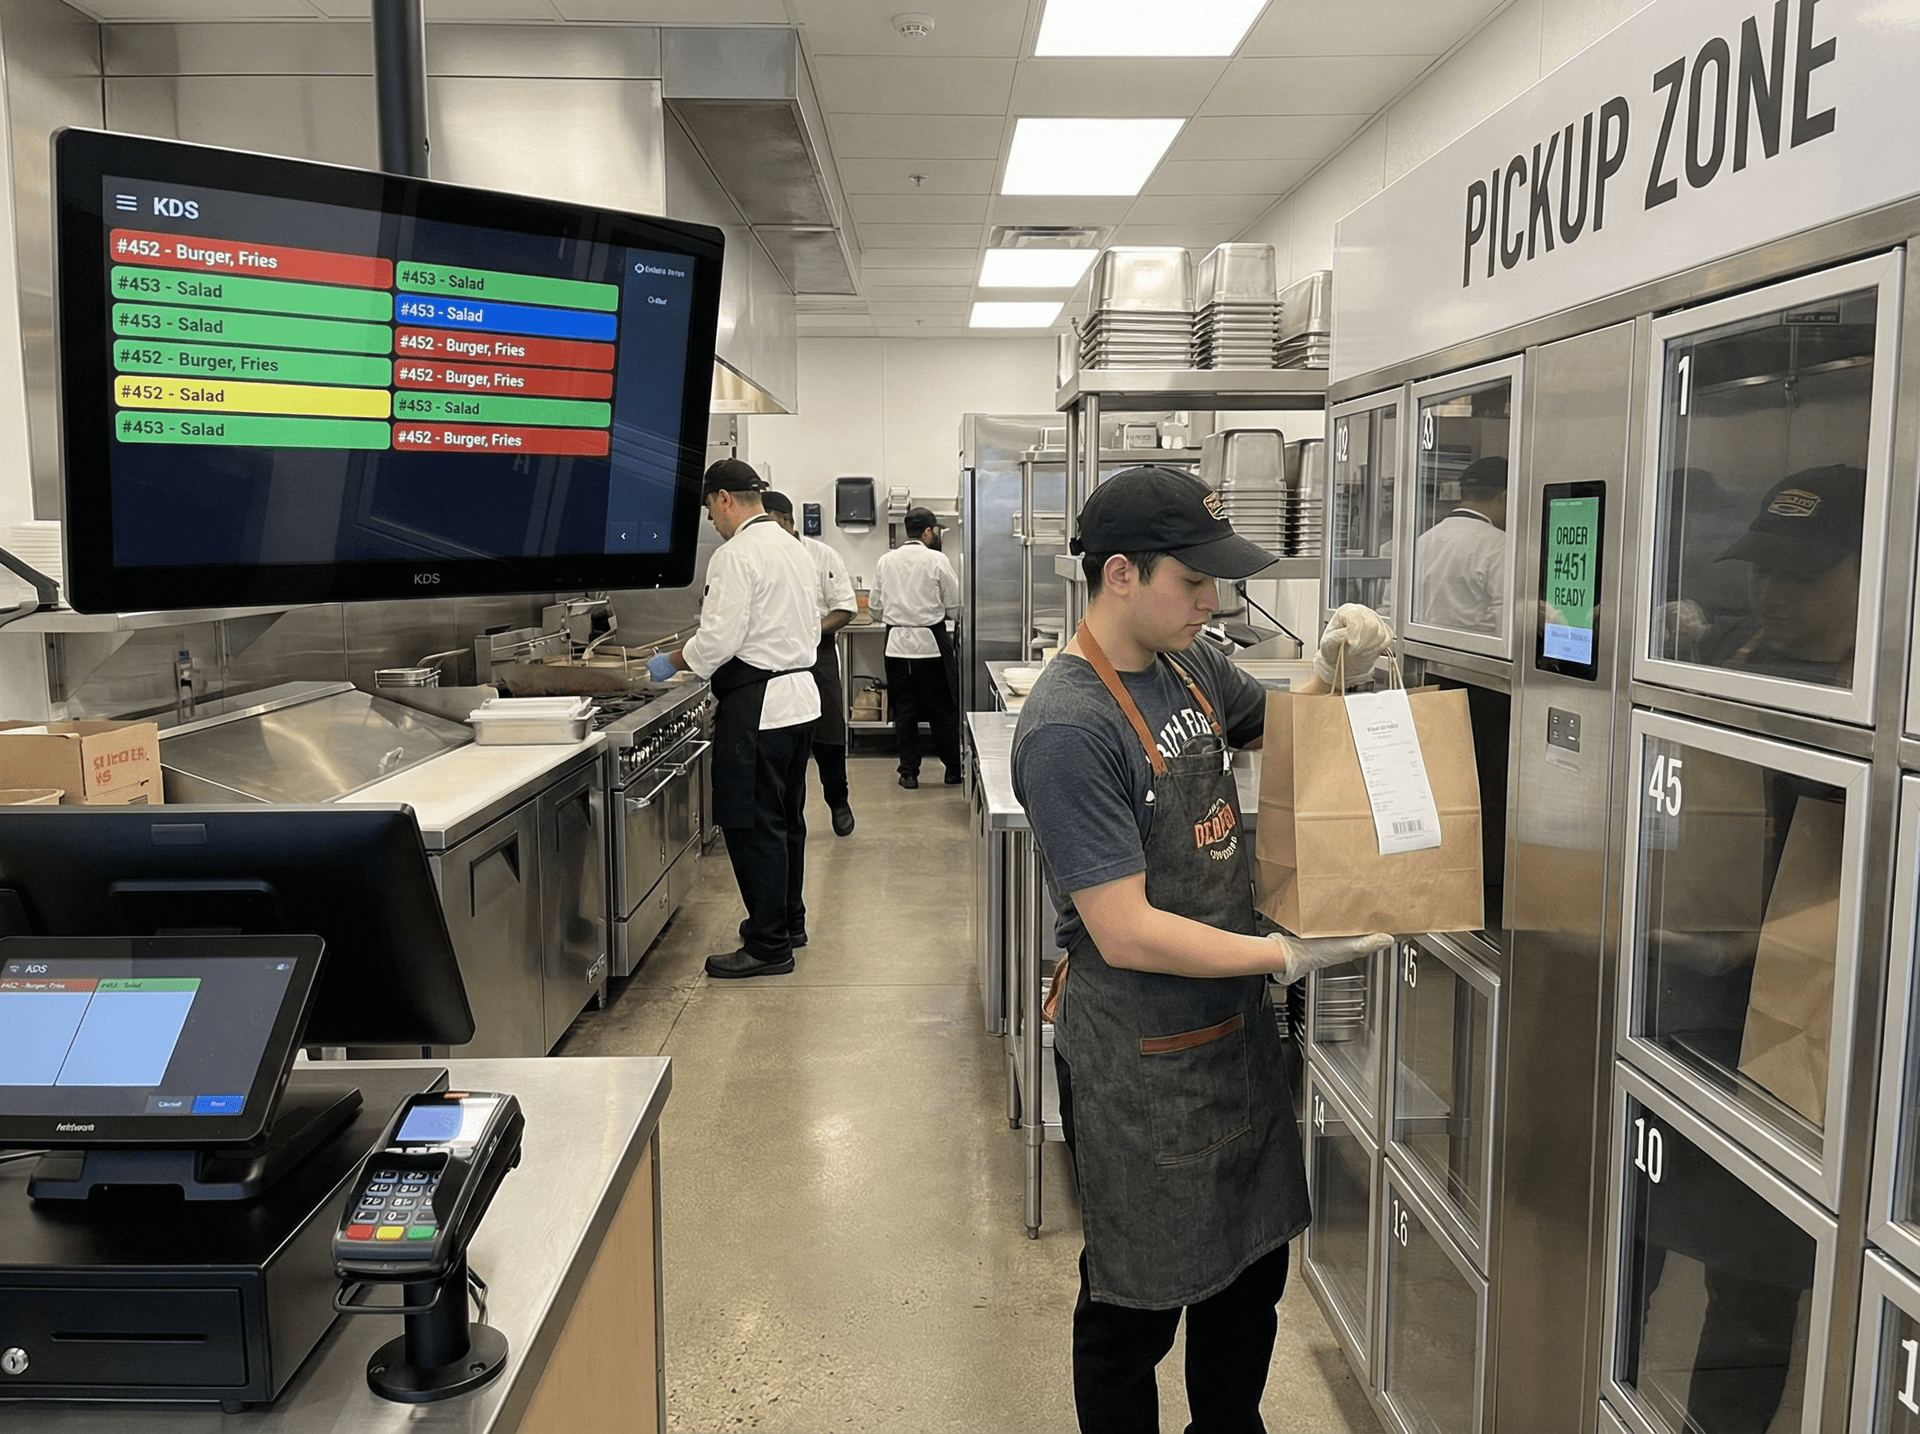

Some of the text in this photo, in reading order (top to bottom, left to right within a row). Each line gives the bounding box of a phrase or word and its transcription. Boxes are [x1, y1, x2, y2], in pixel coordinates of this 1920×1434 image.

[1463, 0, 1837, 288] PICKUP ZONE
[153, 196, 200, 220] KDS
[116, 238, 160, 257] #452
[176, 243, 235, 268] Burger,
[238, 251, 278, 269] Fries
[118, 276, 161, 293] #453
[177, 281, 223, 299] Salad
[402, 269, 436, 285] #453
[449, 276, 485, 291] Salad
[119, 312, 161, 329] #453
[178, 317, 223, 334] Salad
[401, 303, 435, 318] #453
[447, 308, 483, 323] Salad
[400, 336, 434, 350] #452
[446, 339, 492, 357] Burger,
[495, 343, 525, 357] Fries
[120, 348, 162, 366] #452
[179, 352, 236, 372] Burger,
[240, 356, 279, 372] Fries
[399, 367, 433, 382] #452
[446, 371, 492, 388] Burger,
[494, 374, 525, 388] Fries
[1678, 355, 1690, 416] 1
[121, 385, 163, 400] #452
[180, 388, 225, 403] Salad
[398, 400, 432, 413] #453
[445, 402, 480, 416] Salad
[122, 419, 164, 435] #453
[180, 422, 225, 437] Salad
[398, 431, 432, 444] #452
[444, 432, 489, 448] Burger,
[492, 434, 522, 447] Fries
[1556, 526, 1588, 546] ORDER
[1554, 552, 1587, 581] #451
[414, 573, 441, 585] KDS
[1554, 587, 1586, 607] READY
[1648, 754, 1683, 817] 45
[1403, 944, 1418, 988] 15
[1634, 1117, 1663, 1184] 10
[1393, 1199, 1408, 1247] 16
